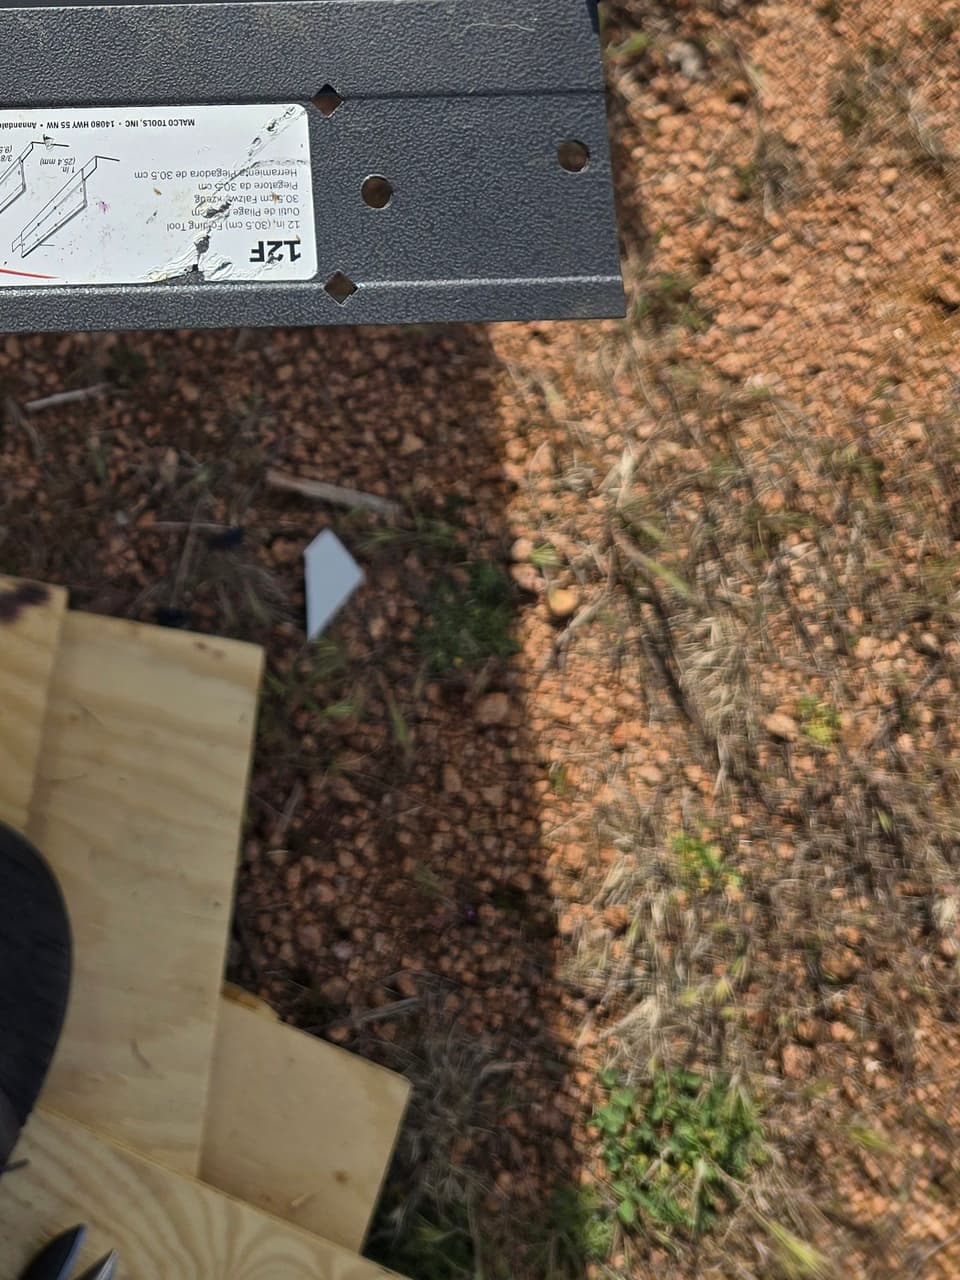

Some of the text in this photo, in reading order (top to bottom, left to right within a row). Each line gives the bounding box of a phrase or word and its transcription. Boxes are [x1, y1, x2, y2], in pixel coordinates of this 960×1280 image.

[46, 121, 58, 129] NW
[60, 121, 70, 129] 55
[72, 121, 89, 129] HWY
[90, 120, 114, 128] 14080
[125, 120, 138, 128] INC
[140, 119, 167, 128] TOOLS,
[168, 119, 195, 127] MALCO
[0, 154, 12, 162] 3/8
[40, 157, 76, 166] (25.4 mm)
[134, 171, 148, 179] cm
[150, 171, 173, 180] 30.5
[175, 171, 187, 180] de
[190, 168, 236, 179] Piegadora
[240, 182, 252, 191] da
[254, 180, 298, 191] Piegatore
[233, 207, 261, 217] Pliage
[264, 208, 276, 216] de
[279, 208, 300, 216] Outil
[166, 223, 186, 232] Tool
[226, 221, 242, 230] cm)
[246, 219, 271, 230] (30.5
[288, 220, 300, 229] 12
[250, 240, 301, 262] 12F
